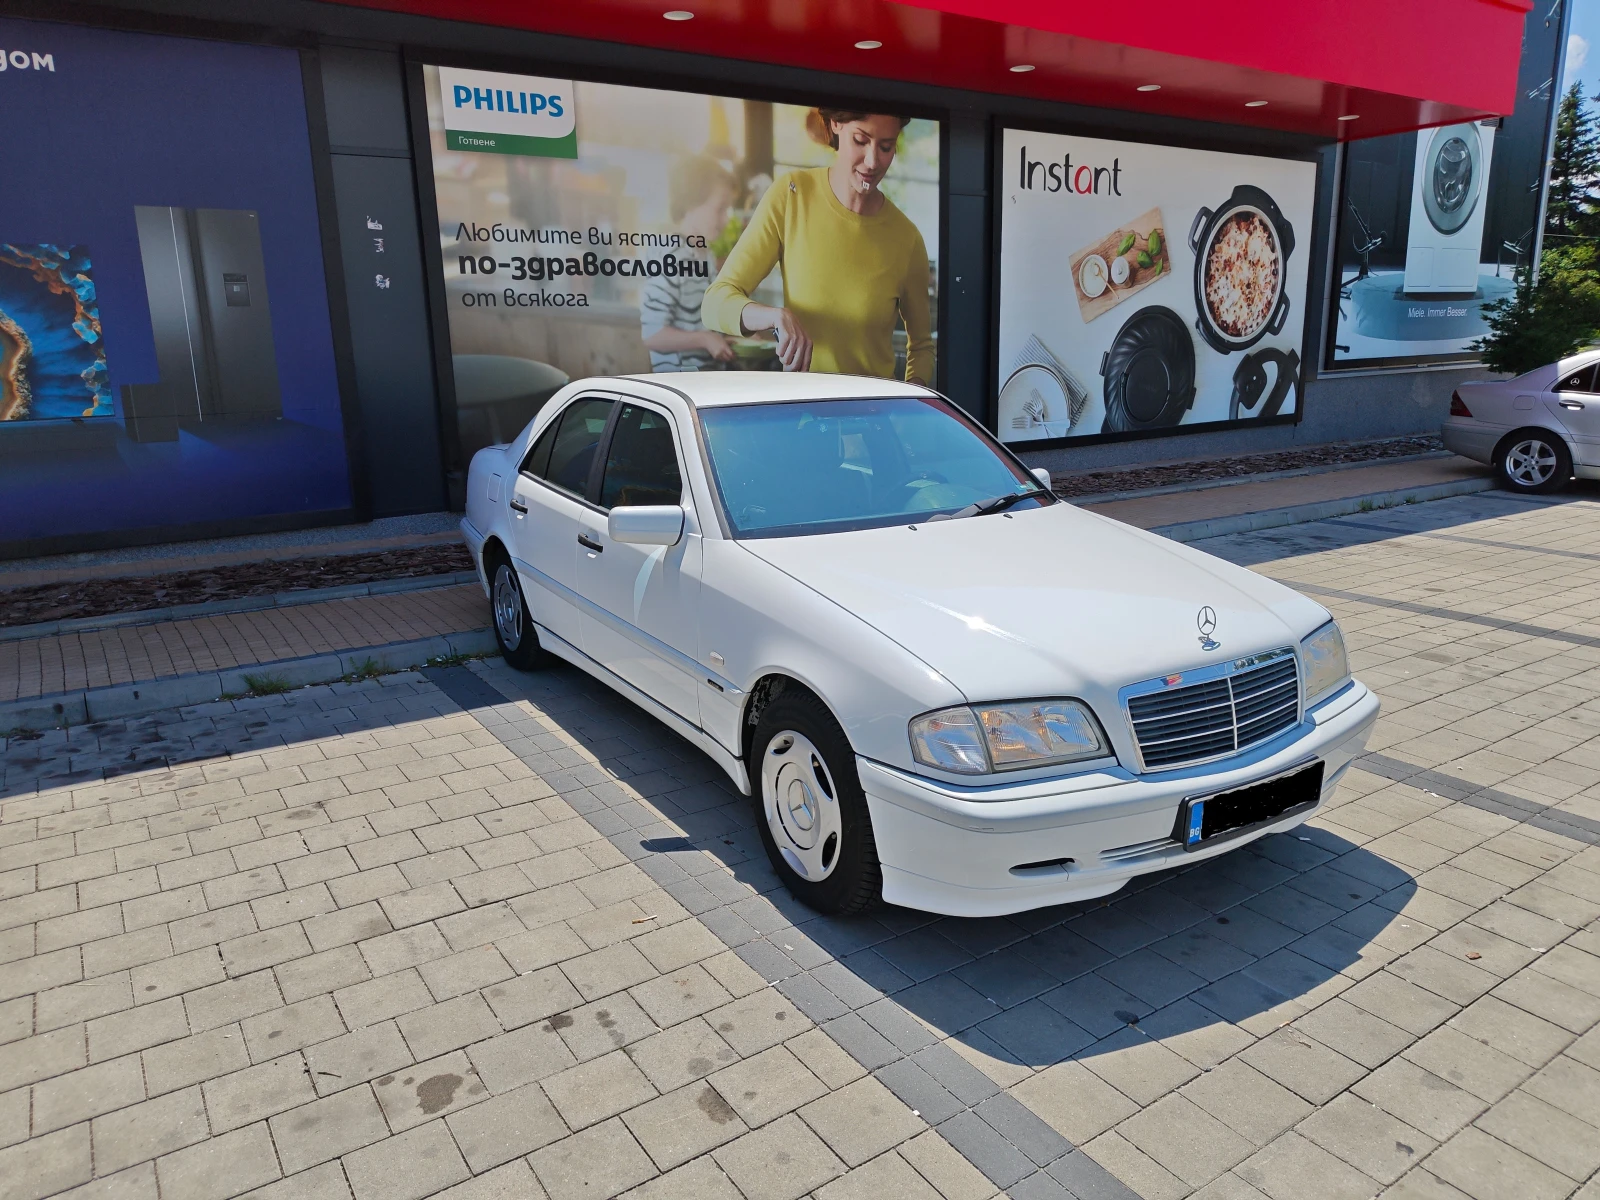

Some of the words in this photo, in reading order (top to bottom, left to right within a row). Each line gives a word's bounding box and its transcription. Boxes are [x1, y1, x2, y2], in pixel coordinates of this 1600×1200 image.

[453, 85, 564, 118] PHILIPS
[458, 136, 496, 147] Готвене
[1020, 145, 1122, 197] Instant
[455, 222, 582, 245] Любимите
[588, 226, 612, 246] ви
[618, 232, 681, 247] ястия
[686, 234, 708, 249] са
[458, 251, 709, 281] по-здравословни
[461, 292, 497, 307] от
[503, 288, 590, 307] всякога
[1408, 307, 1425, 318] Miele.
[1427, 307, 1446, 317] Immer
[1446, 306, 1468, 317] Besser.
[1189, 826, 1200, 838] BG
